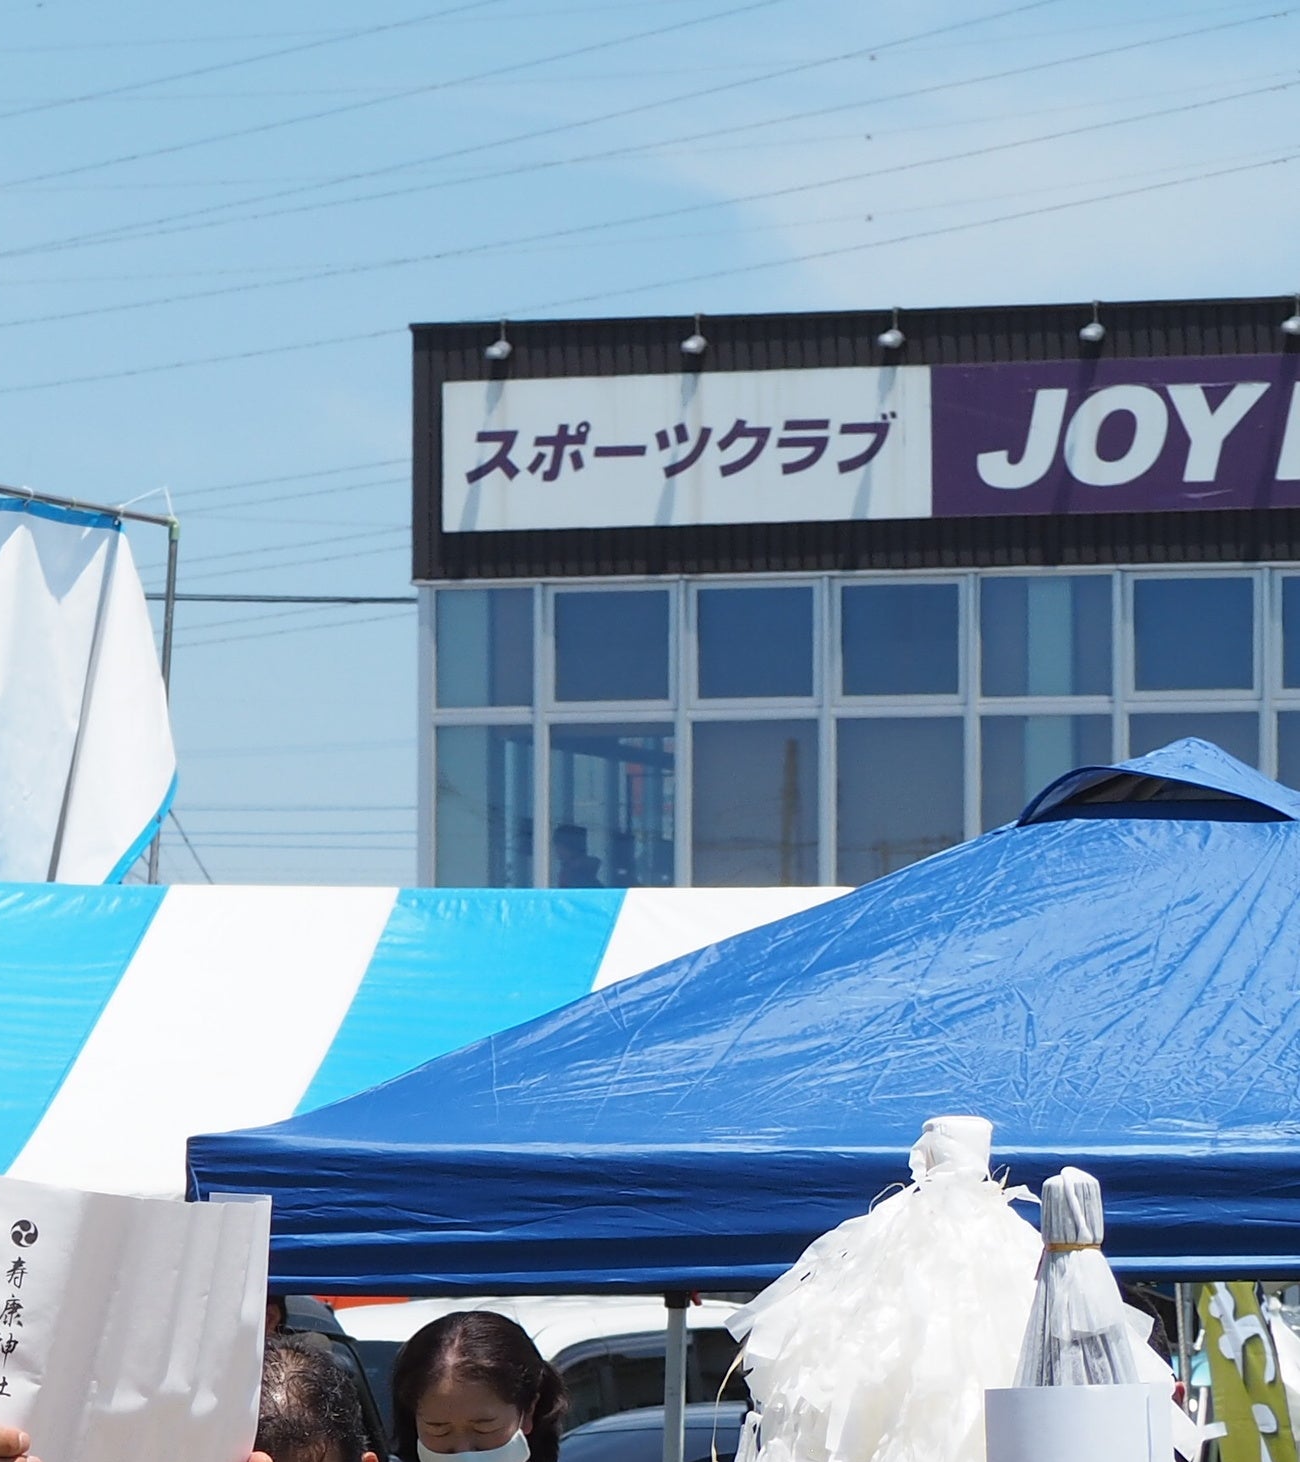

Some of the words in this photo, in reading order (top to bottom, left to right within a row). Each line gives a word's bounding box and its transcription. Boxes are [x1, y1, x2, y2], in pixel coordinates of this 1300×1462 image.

[464, 409, 899, 486] スポーツクラブ
[976, 381, 1272, 491] JOY
